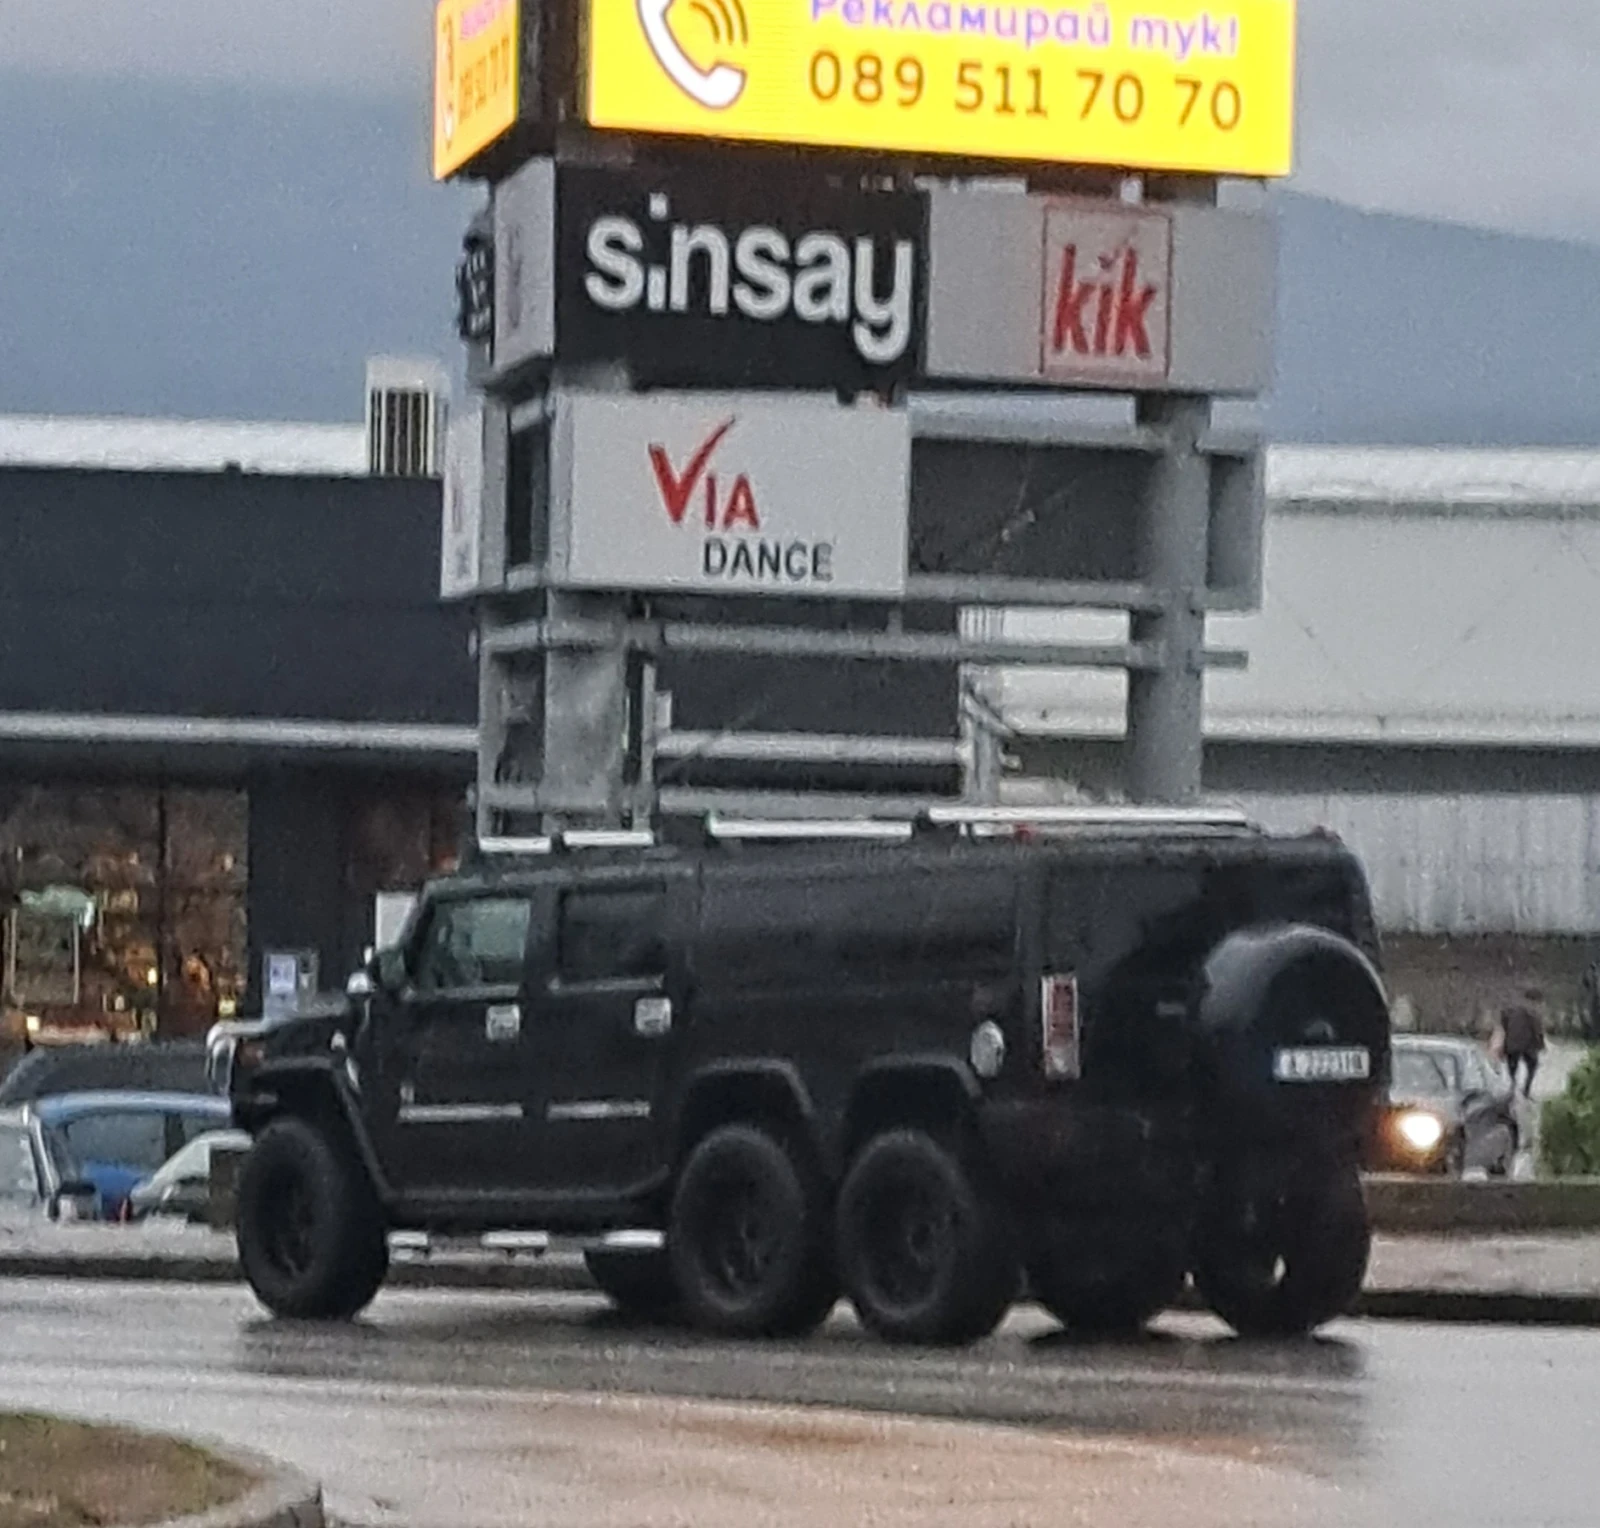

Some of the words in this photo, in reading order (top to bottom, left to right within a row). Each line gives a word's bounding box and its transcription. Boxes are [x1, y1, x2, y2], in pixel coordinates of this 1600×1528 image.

[1131, 12, 1237, 61] тук!
[809, 50, 925, 107] 089
[955, 60, 1048, 118] 511
[1076, 70, 1145, 125] 70
[1174, 76, 1242, 131] 70
[584, 192, 912, 363] sinsay
[1053, 243, 1157, 358] kik
[648, 414, 760, 530] VIA
[703, 537, 834, 581] DANCE
